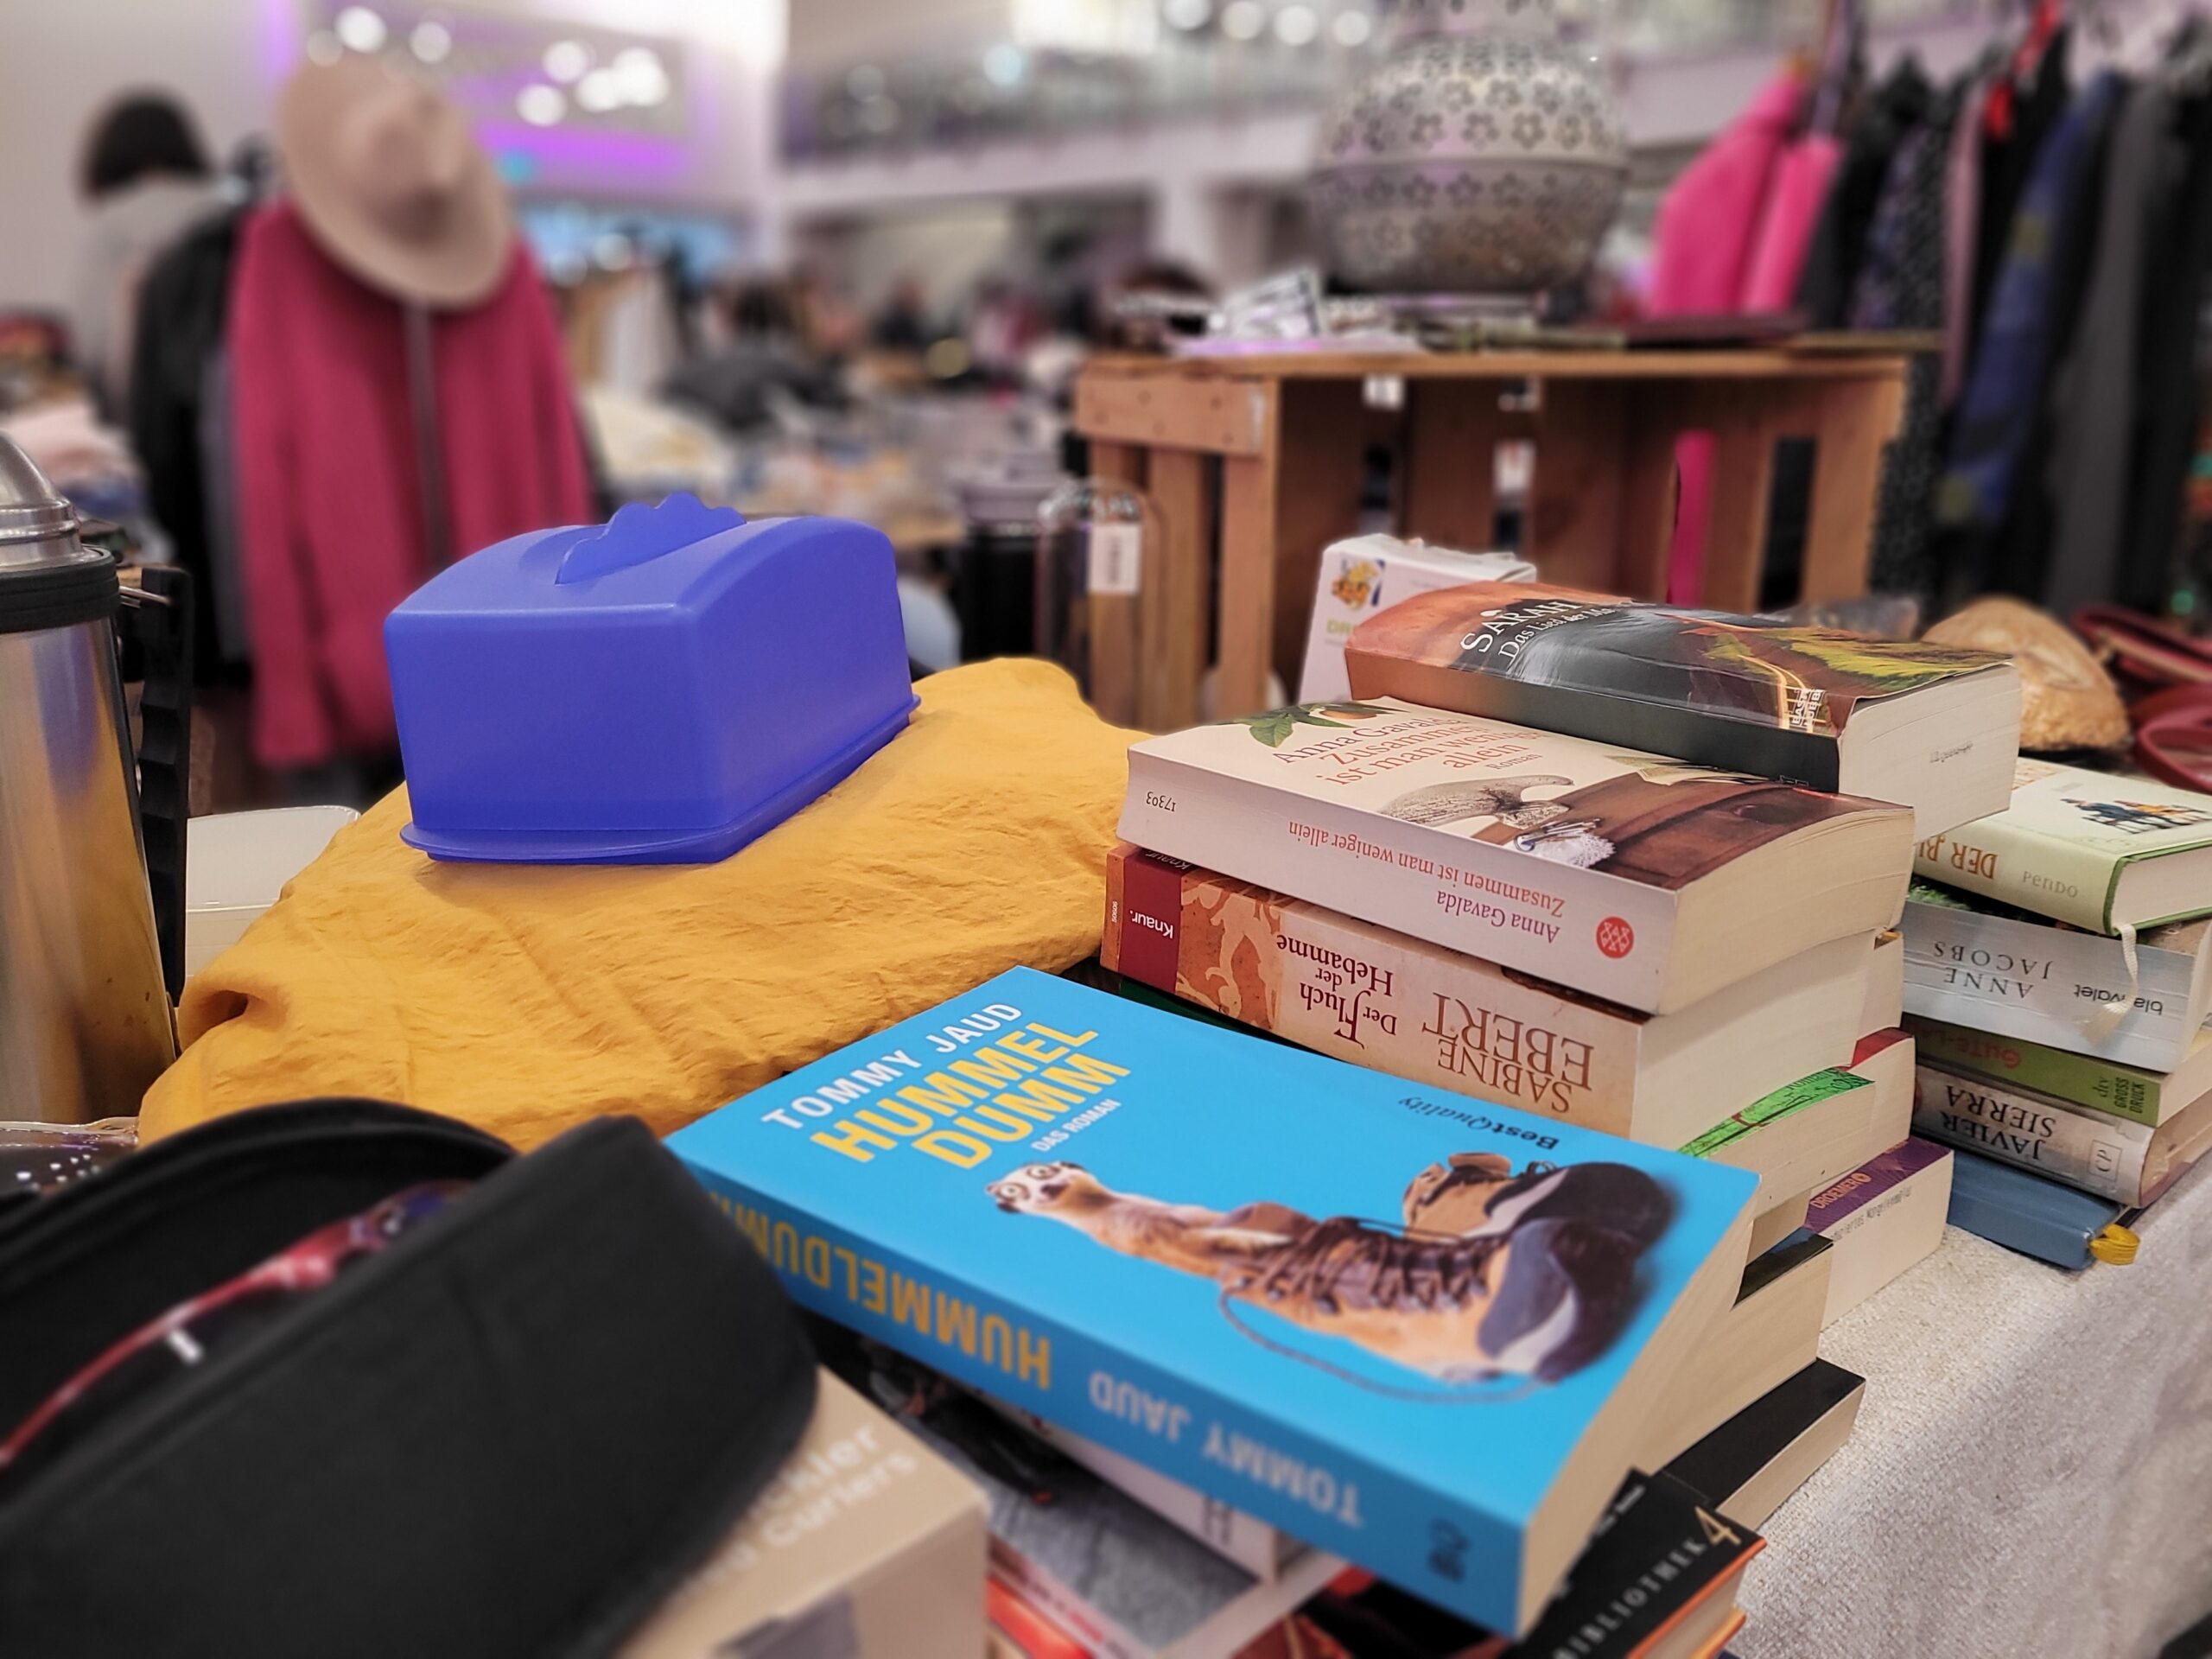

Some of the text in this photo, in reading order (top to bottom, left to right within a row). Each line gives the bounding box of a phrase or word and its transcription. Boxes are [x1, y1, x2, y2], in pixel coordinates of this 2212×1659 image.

[1460, 602, 1582, 652] SARAH
[1498, 630, 1535, 663] Das
[1528, 617, 1567, 632] Lied
[1273, 716, 1470, 764] Anna Gavalda
[1316, 732, 1550, 785] ist man weniger
[1319, 724, 1490, 766] Zusammen
[1443, 744, 1529, 768] allein
[1484, 753, 1542, 770] Roman
[1146, 791, 1177, 812] 17303
[1288, 820, 1566, 918] Zusammen ist man weniger allein
[1951, 842, 1999, 880] DER
[1129, 910, 1174, 939] Knaur.
[1436, 890, 1560, 944] Anna Gavalda
[1276, 933, 1394, 997] Hebamme
[1314, 969, 1343, 992] der
[1933, 941, 2053, 980] JACOBS
[1943, 967, 2034, 999] ANNE
[1300, 982, 1397, 1050] Der Fluch
[2074, 984, 2163, 1015] blavalet
[760, 1002, 1022, 1129] TOMMY JAUD
[1421, 992, 1595, 1092] EBERT
[810, 1022, 1098, 1163] HUMMEL
[1437, 1038, 1572, 1115] SABINE
[2128, 1081, 2145, 1114] DRUCK
[912, 1052, 1131, 1170] DUMM
[1030, 1098, 1122, 1152] DAS ROMAN
[1940, 1111, 2047, 1160] JAVIER
[1946, 1084, 2056, 1138] SIERRA
[1089, 1370, 1192, 1444] JAUD
[1202, 1421, 1363, 1529] TOMMY
[1694, 1505, 1742, 1546] 4
